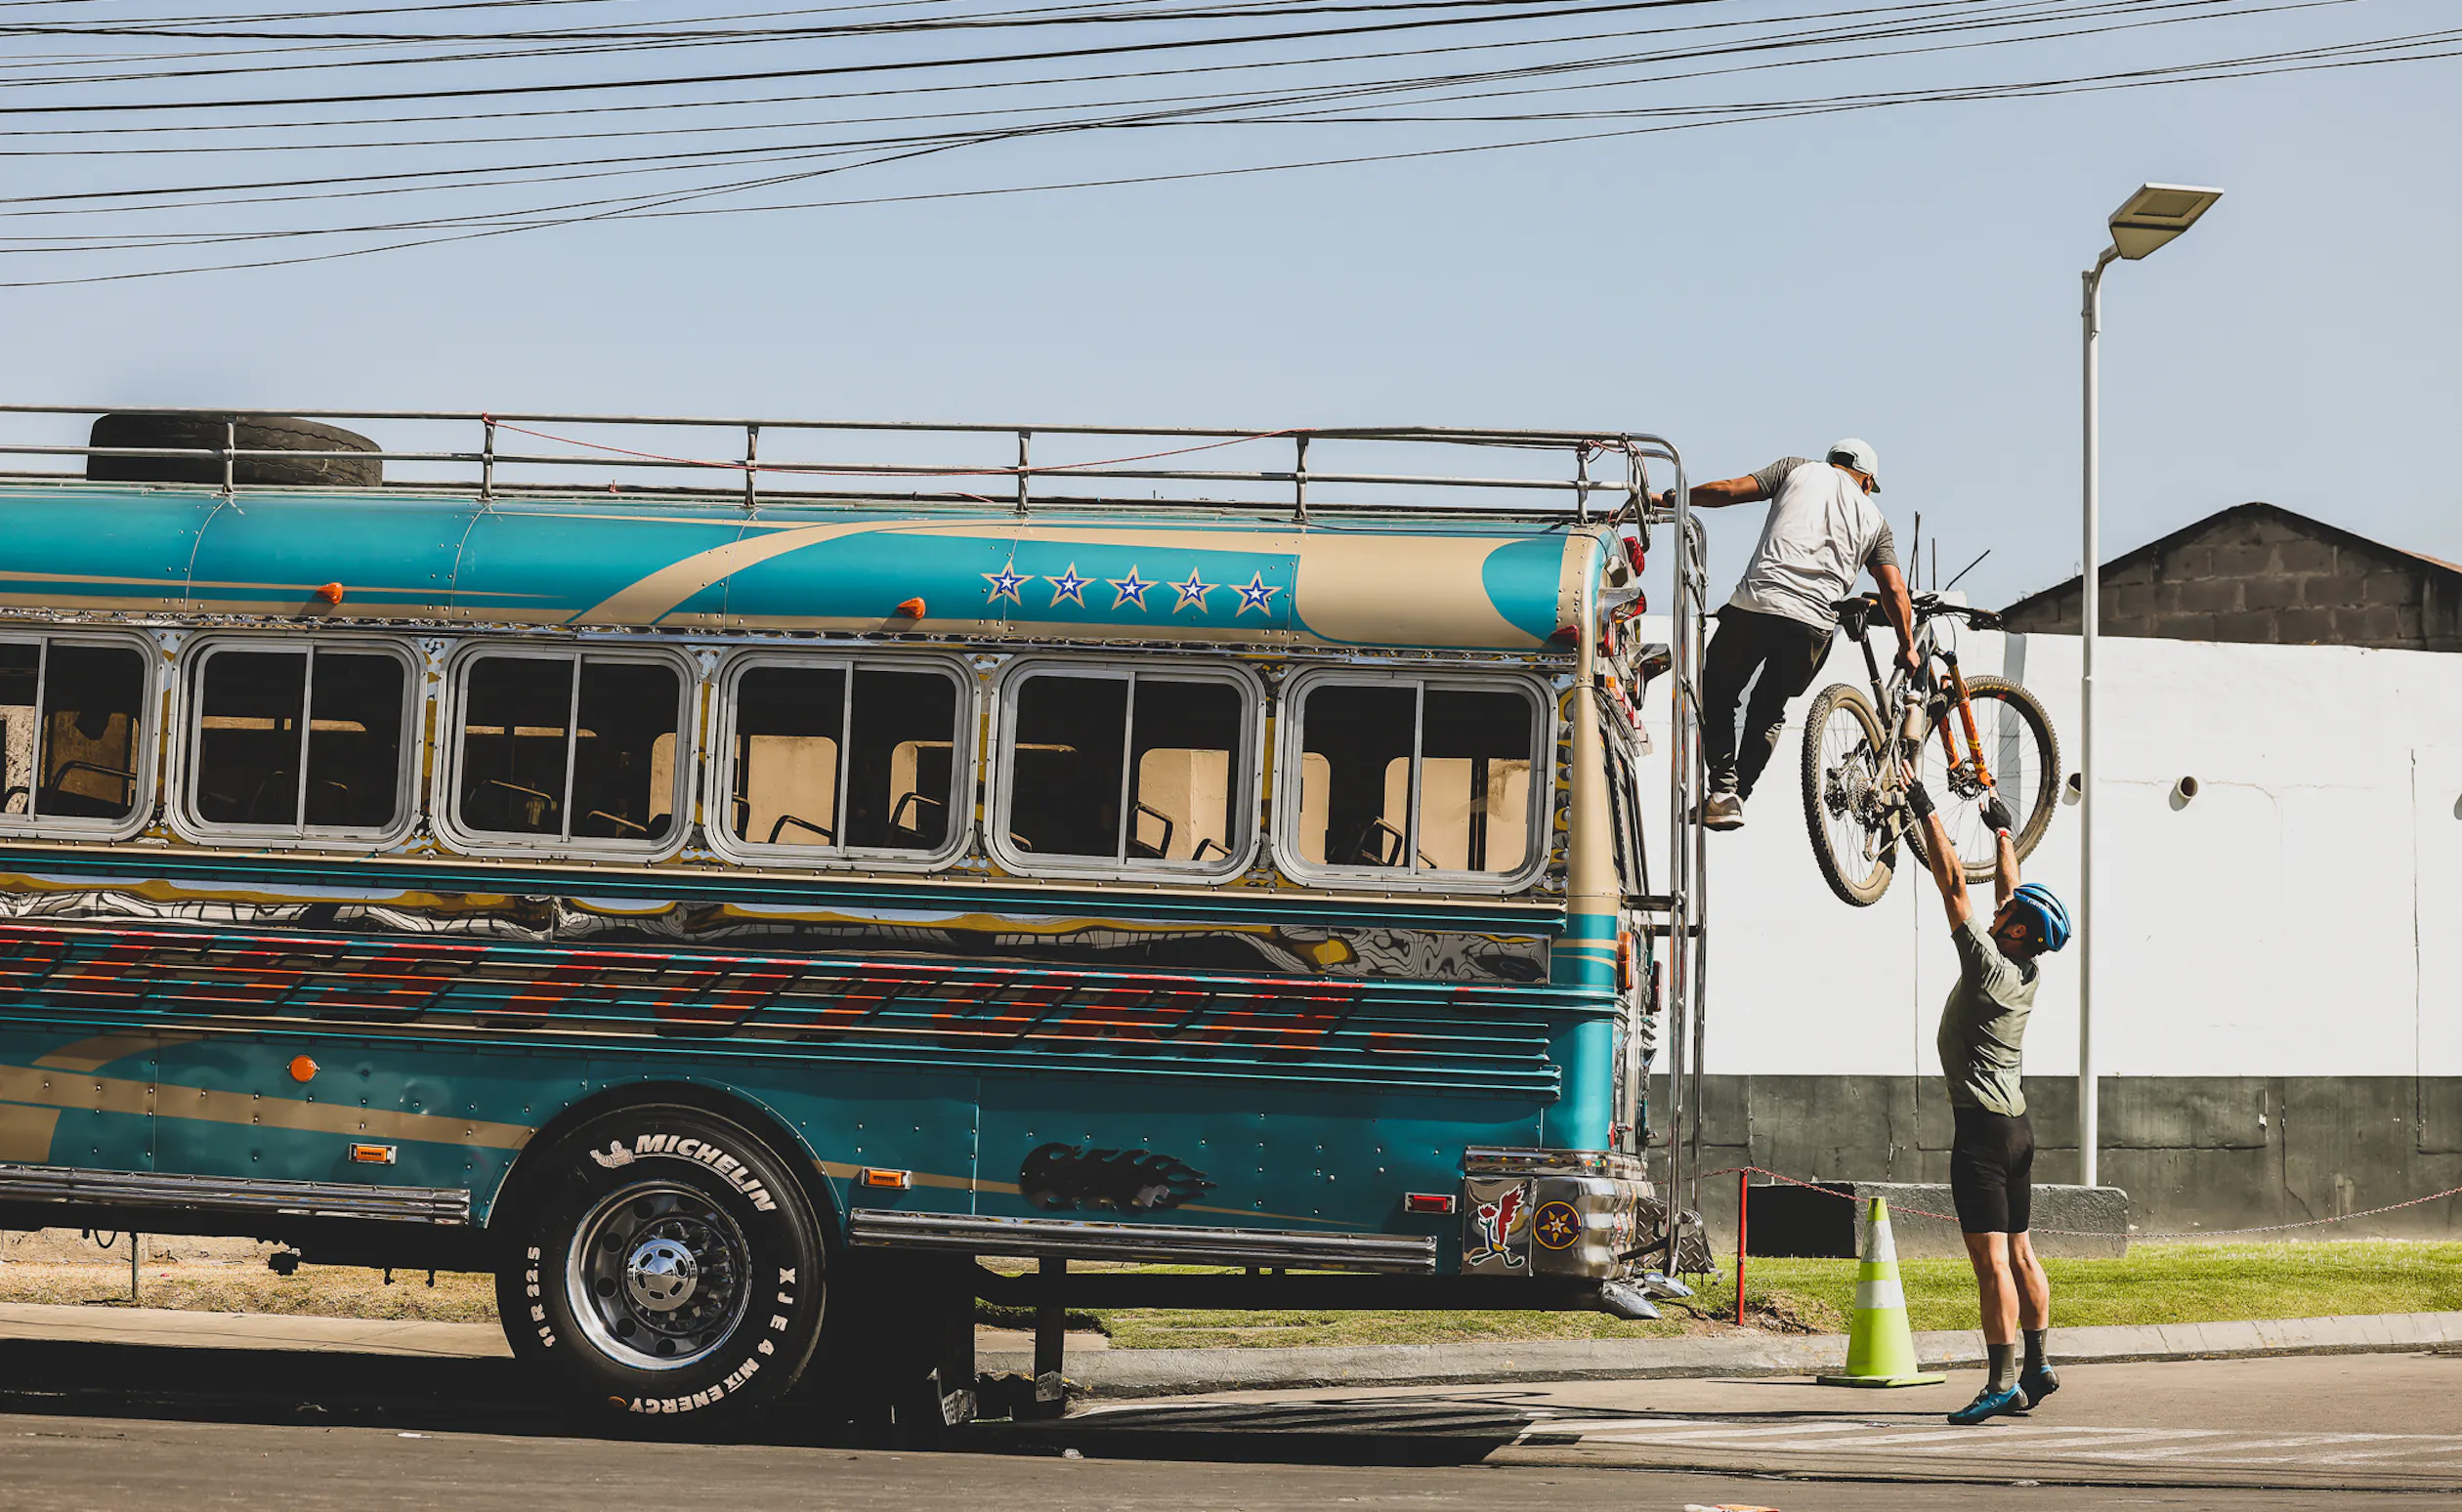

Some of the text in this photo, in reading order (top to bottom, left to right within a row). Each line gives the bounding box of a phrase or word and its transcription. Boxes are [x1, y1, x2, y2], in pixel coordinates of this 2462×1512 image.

[634, 1133, 778, 1212] MICHELIN
[526, 1246, 540, 1297] 22.5
[629, 1383, 725, 1414] ENERGY
